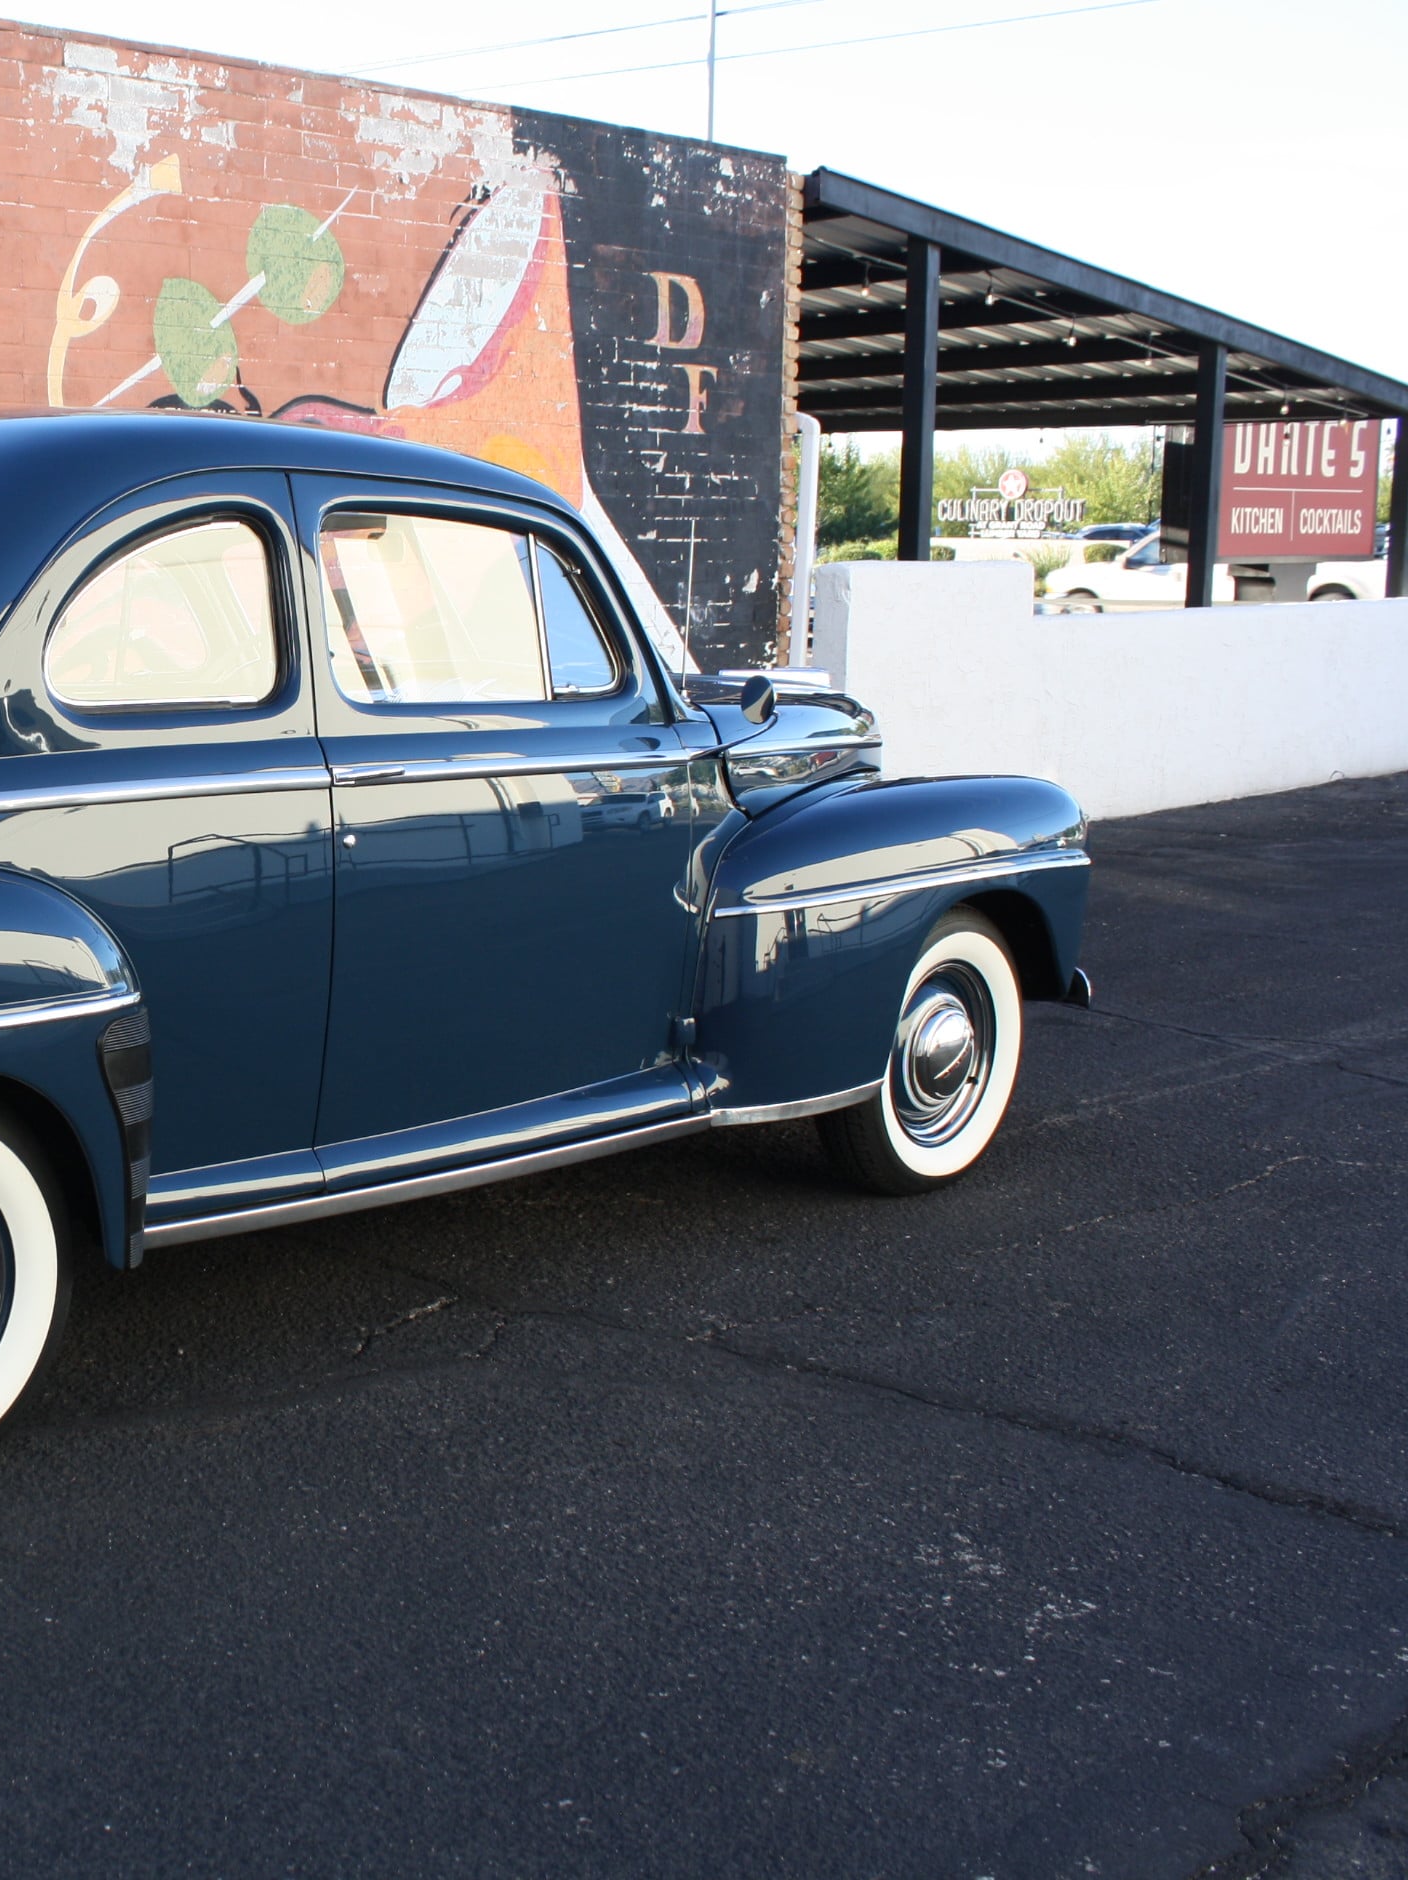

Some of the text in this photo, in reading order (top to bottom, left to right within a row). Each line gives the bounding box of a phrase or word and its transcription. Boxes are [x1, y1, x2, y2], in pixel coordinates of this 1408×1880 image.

[643, 272, 705, 349] D
[679, 364, 718, 435] F
[937, 499, 1085, 522] CULINARY DROPOUT
[1230, 507, 1362, 535] KITCHEN COCKTAILS
